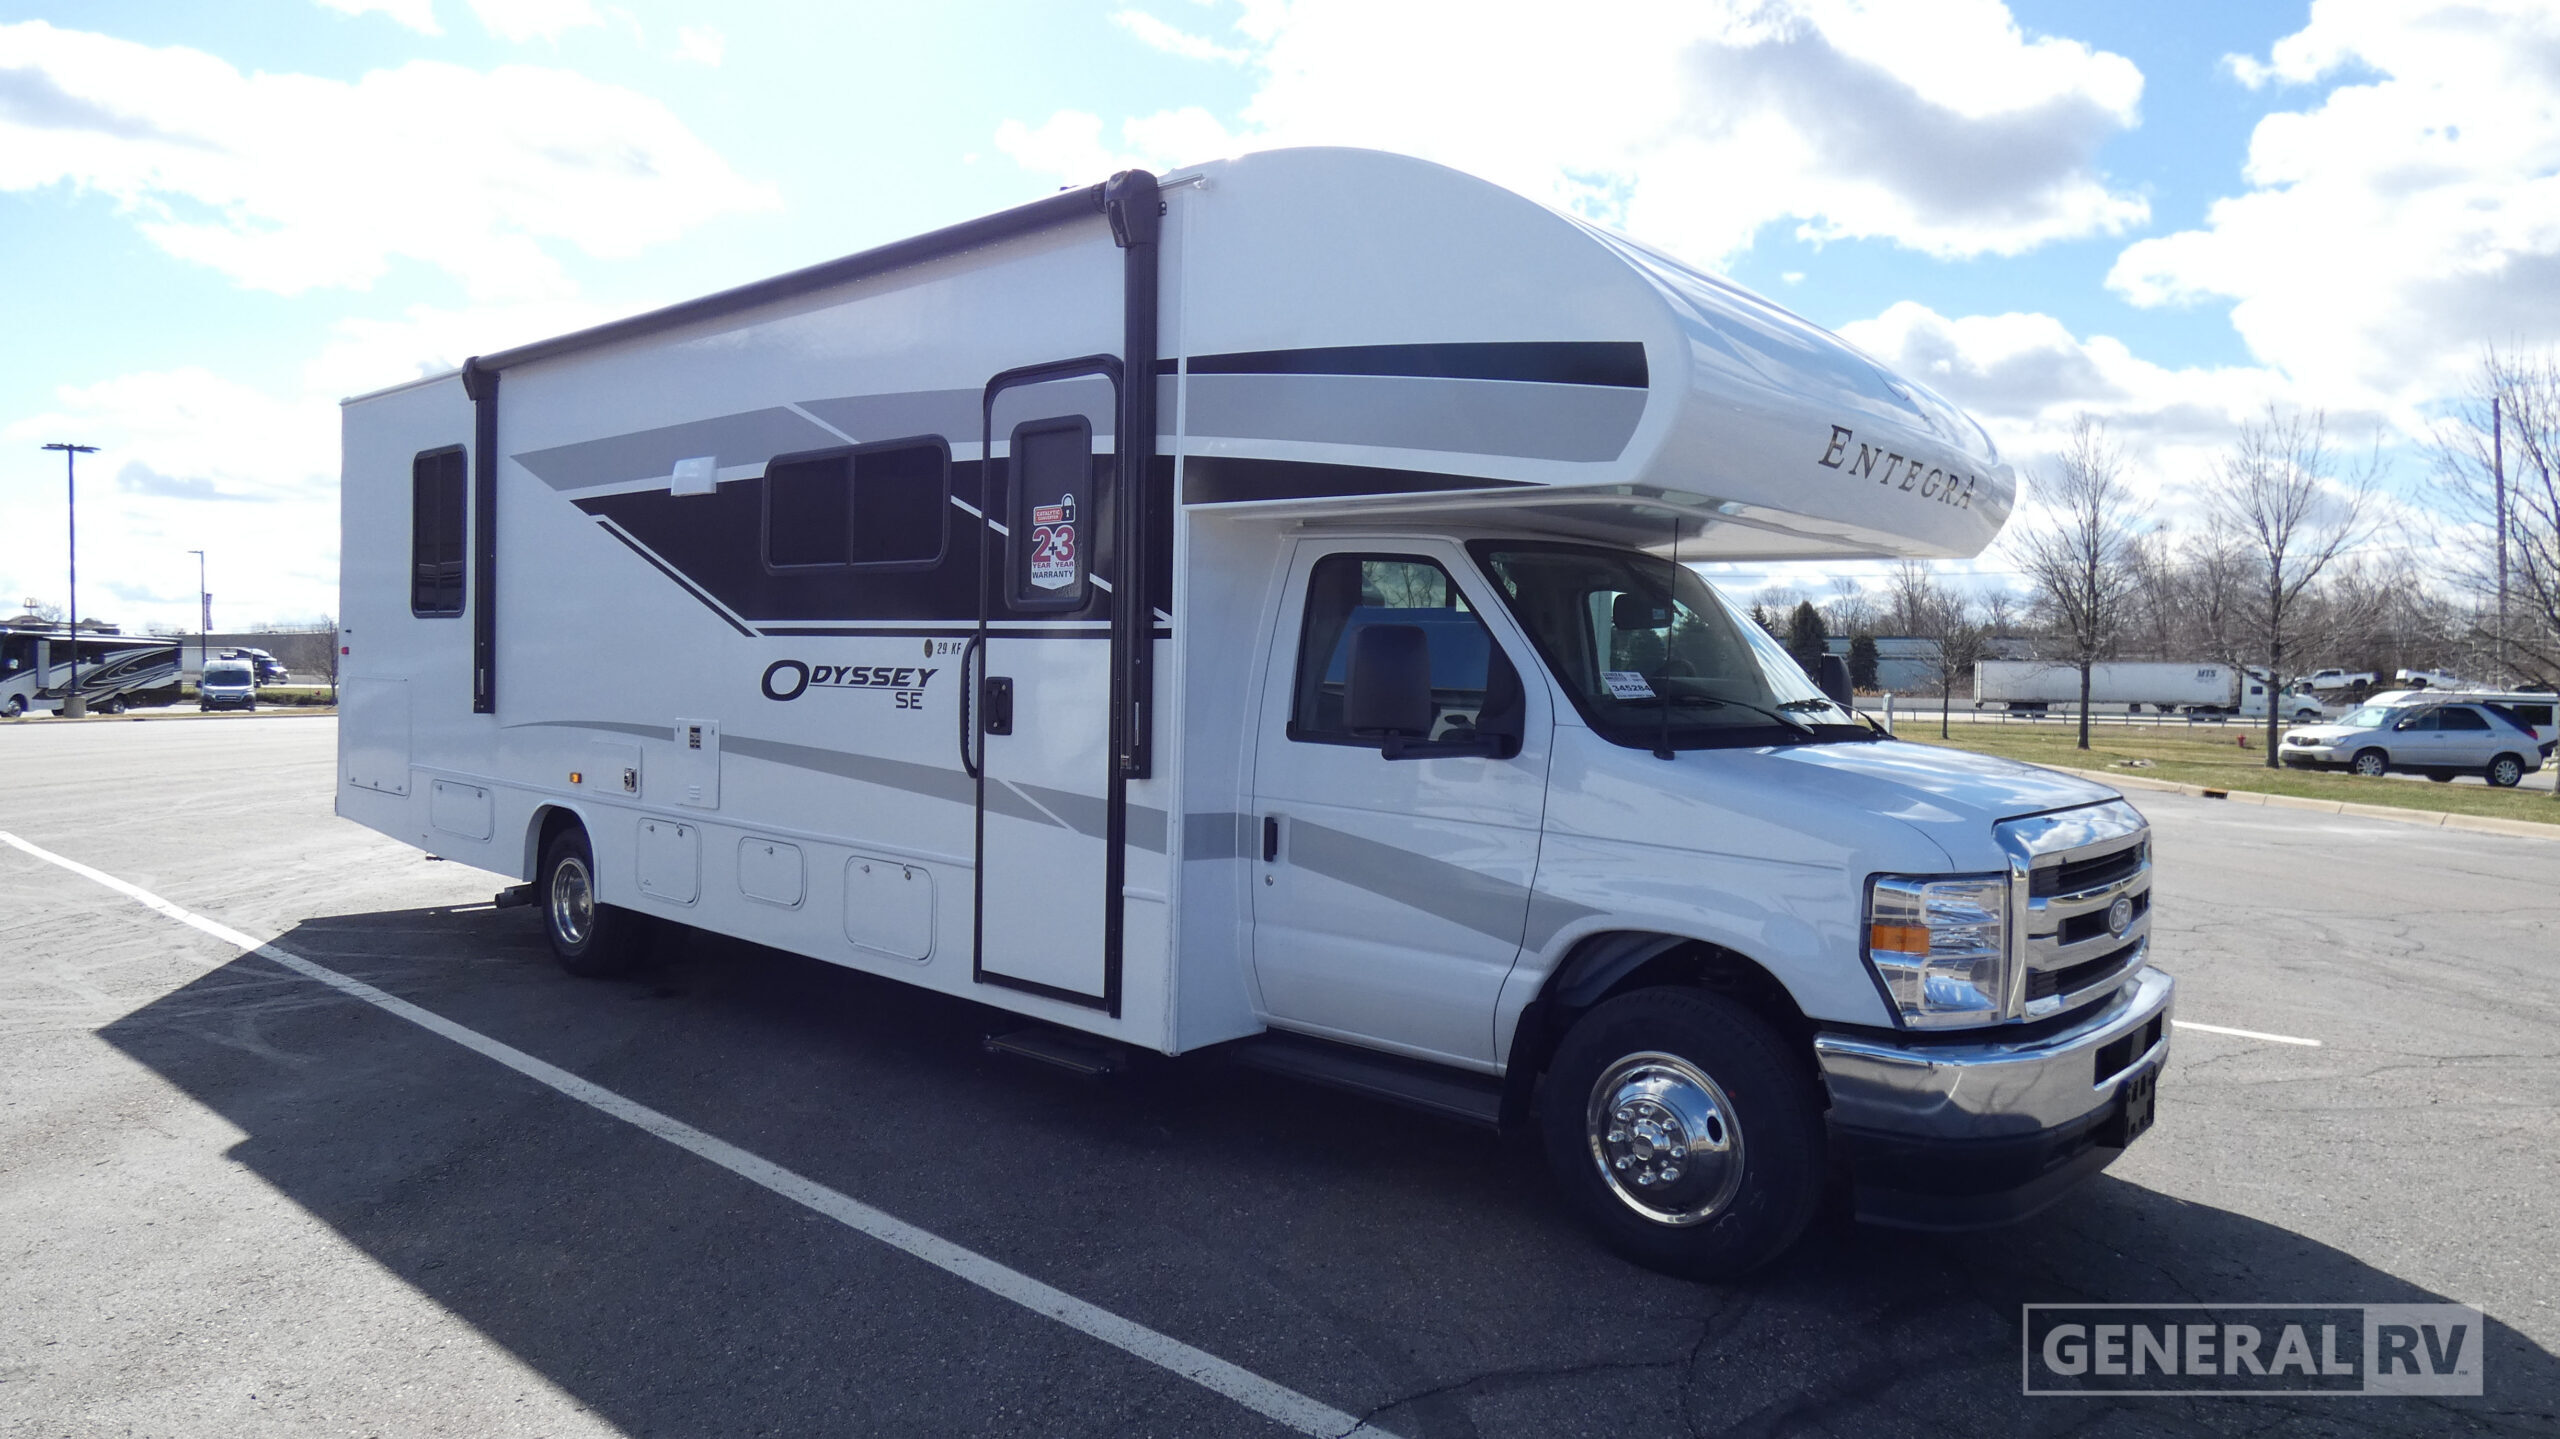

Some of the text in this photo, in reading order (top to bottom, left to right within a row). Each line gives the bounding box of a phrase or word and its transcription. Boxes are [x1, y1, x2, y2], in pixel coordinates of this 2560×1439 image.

[1818, 424, 1975, 510] ENTEGRA
[1032, 570, 1074, 579] WARRANTY
[937, 642, 962, 655] 29 KF
[761, 659, 939, 702] ODYSSEY
[895, 692, 923, 710] SE
